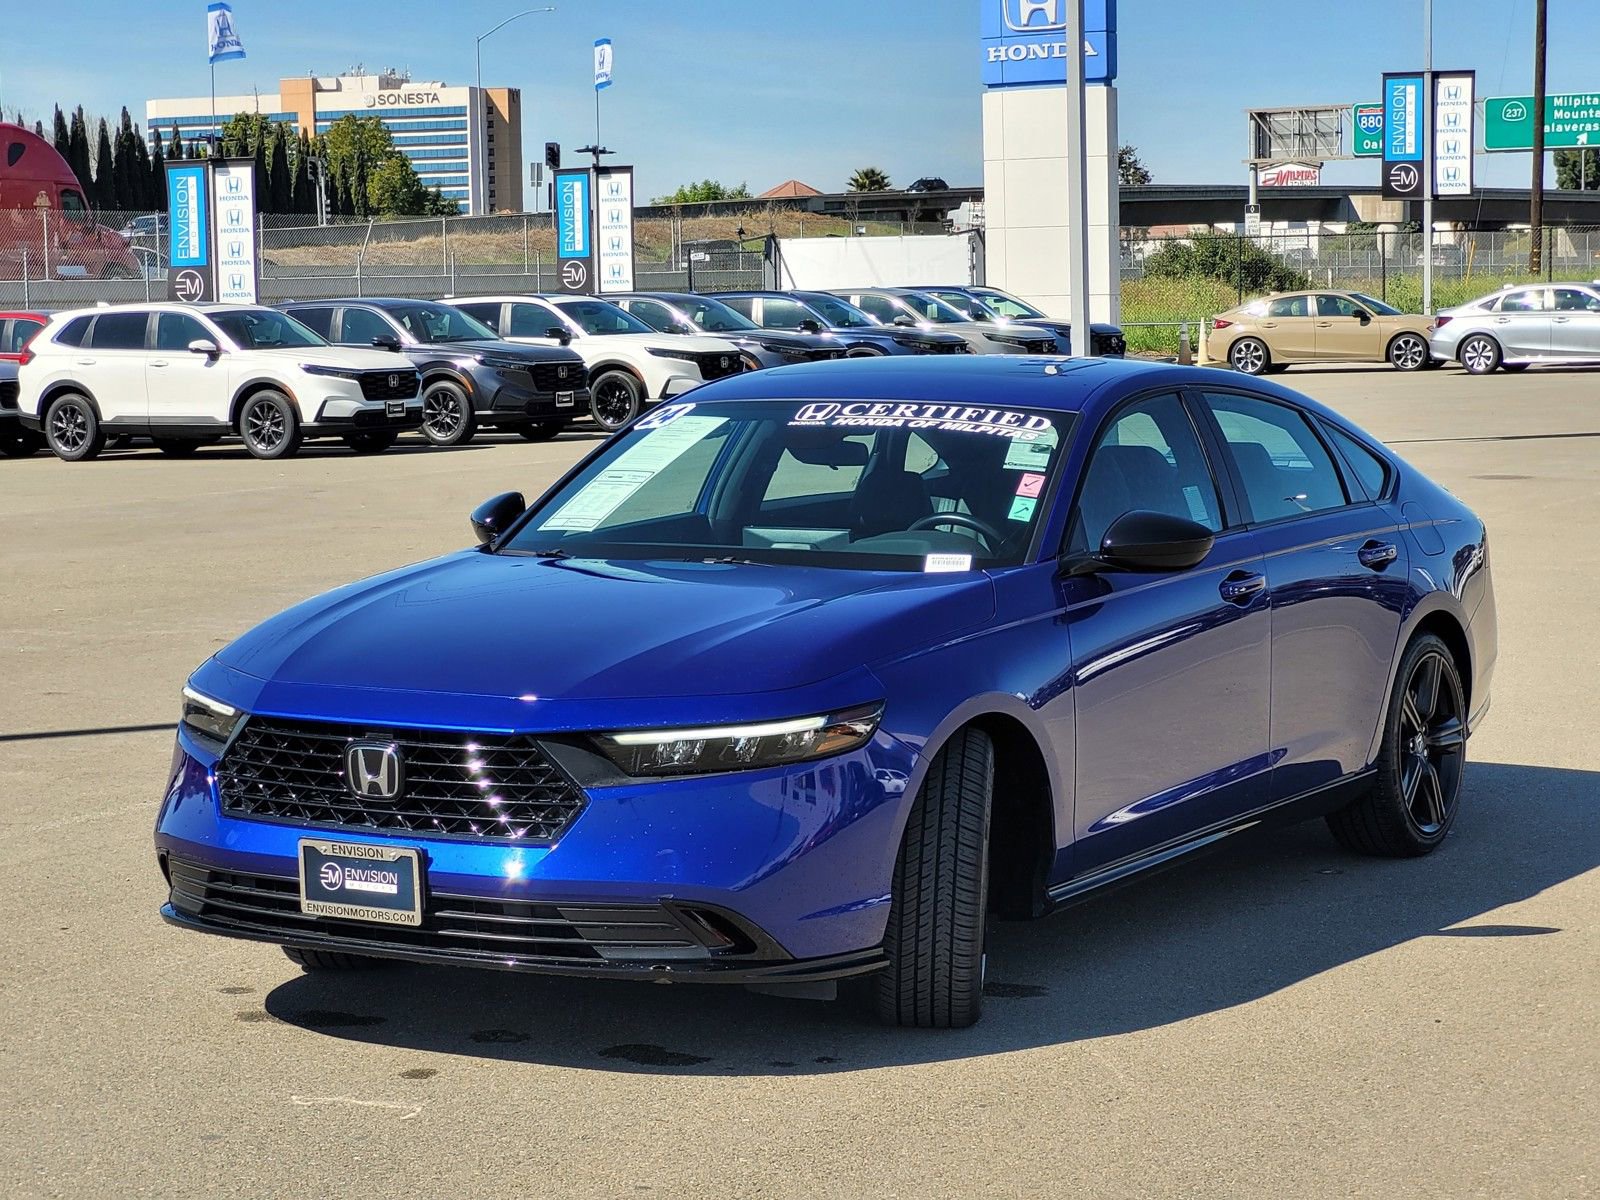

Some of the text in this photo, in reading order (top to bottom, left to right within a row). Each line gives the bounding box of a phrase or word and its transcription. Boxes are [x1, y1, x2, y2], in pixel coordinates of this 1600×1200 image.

[377, 92, 440, 105] SONESTA
[1360, 116, 1382, 129] 880
[1392, 85, 1406, 155] ENVISION
[1506, 108, 1522, 118] 237
[1544, 123, 1599, 133] alaveras
[176, 176, 189, 259] ENVISION
[562, 181, 575, 252] ENVISION
[842, 403, 1052, 431] CERTIFIED
[832, 418, 1039, 440] HONDA OF MILPITAS
[331, 844, 384, 859] ENVISION
[344, 867, 398, 885] ENVISION
[306, 902, 416, 924] ENVISIONMOTORS.COM
